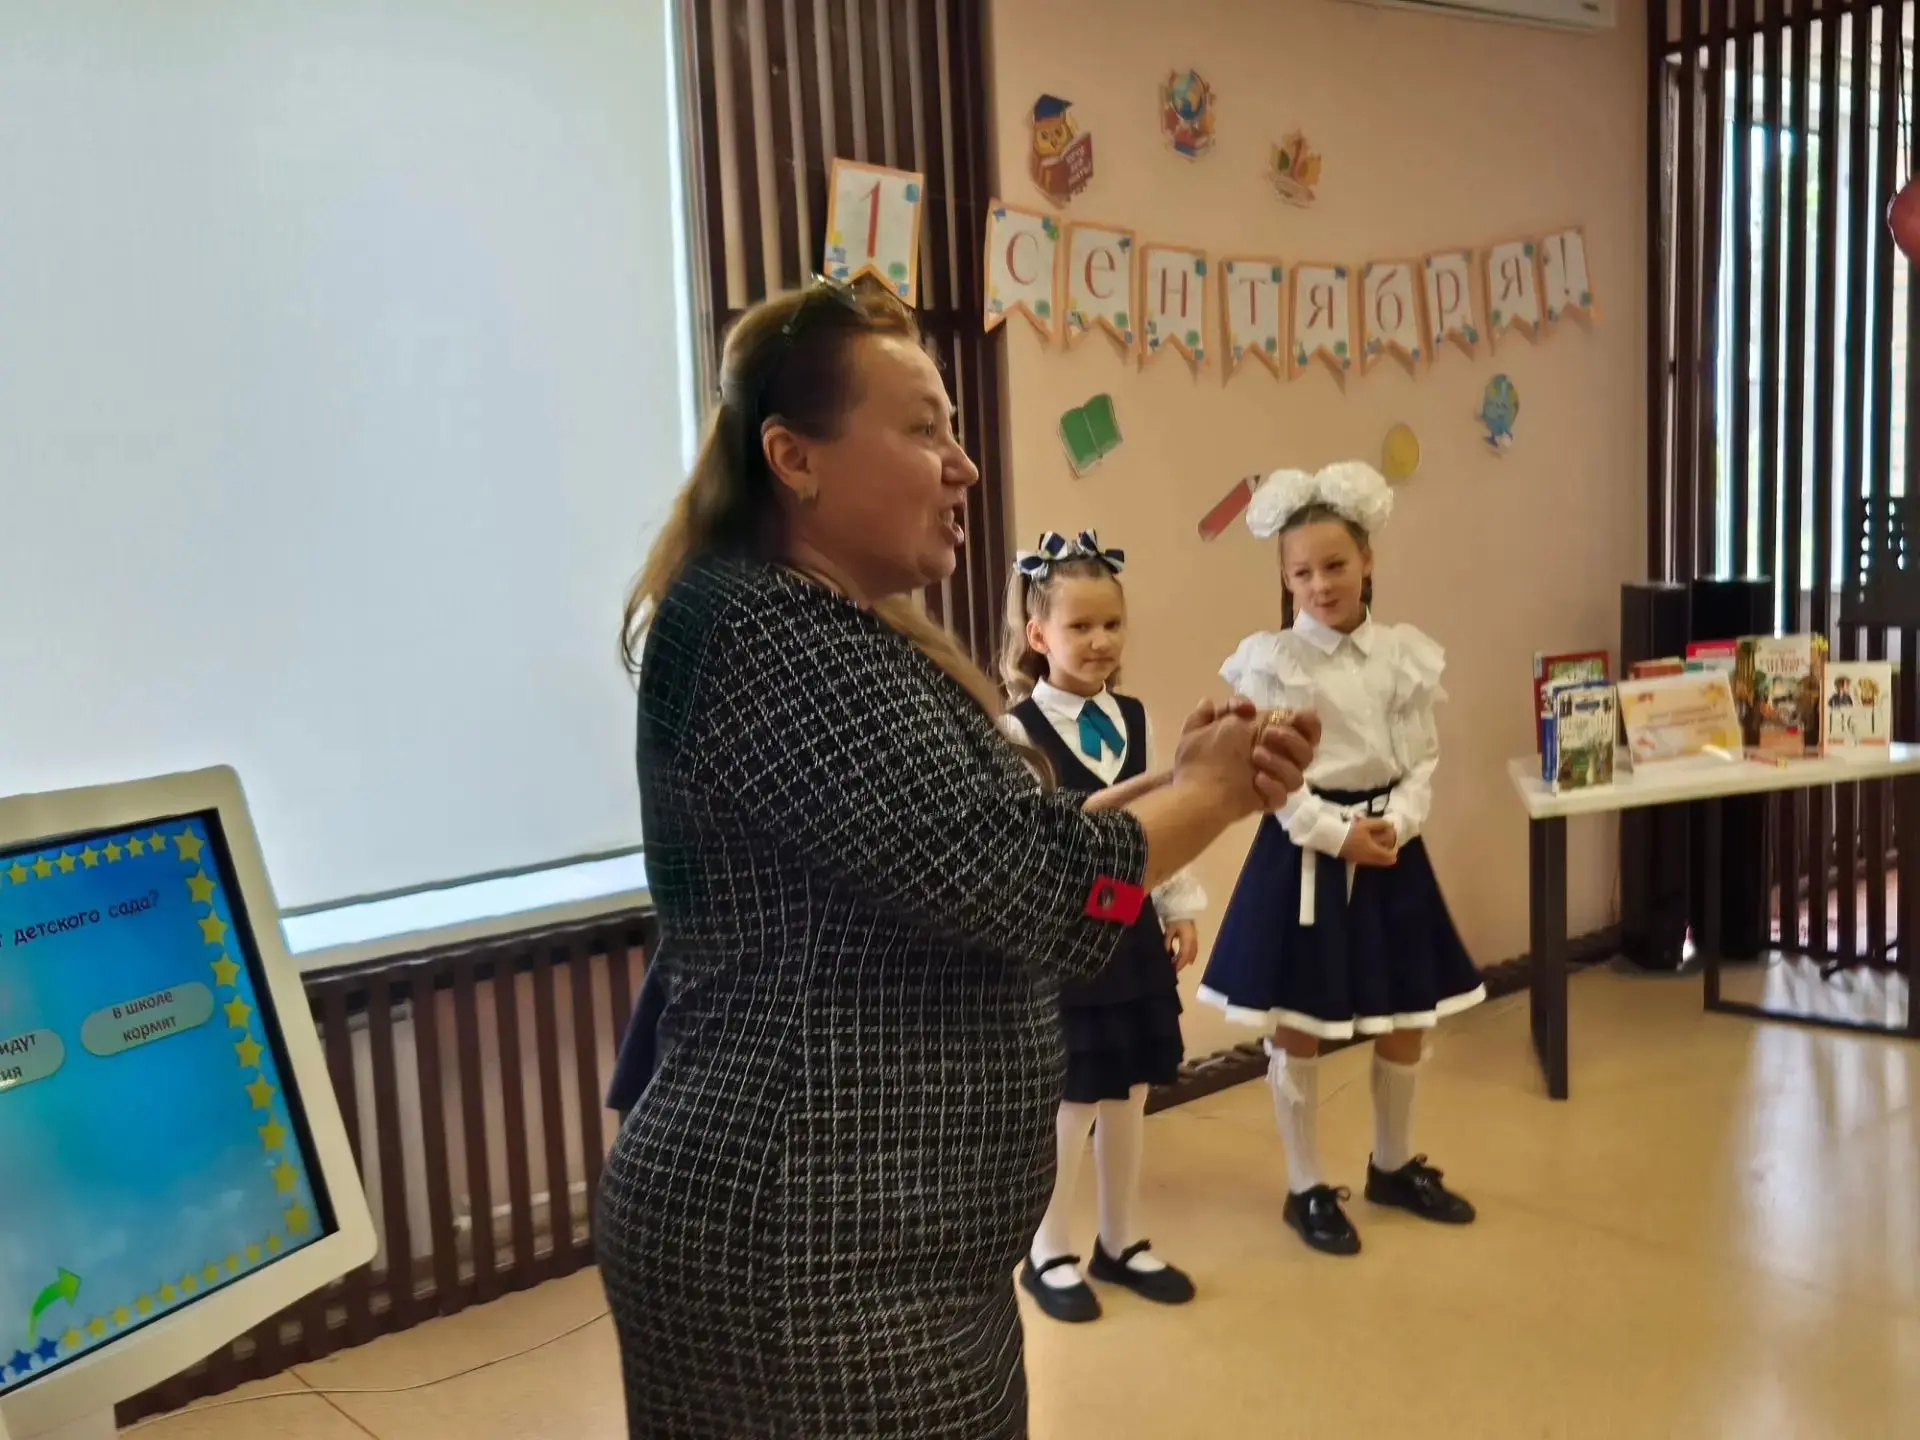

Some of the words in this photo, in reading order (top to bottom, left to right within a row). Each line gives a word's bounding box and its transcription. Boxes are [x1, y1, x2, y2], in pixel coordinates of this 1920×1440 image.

[858, 180, 880, 258] 1
[14, 908, 100, 946] детского
[108, 889, 160, 919] сада?
[126, 990, 174, 1016] школе
[122, 1016, 177, 1043] кормят
